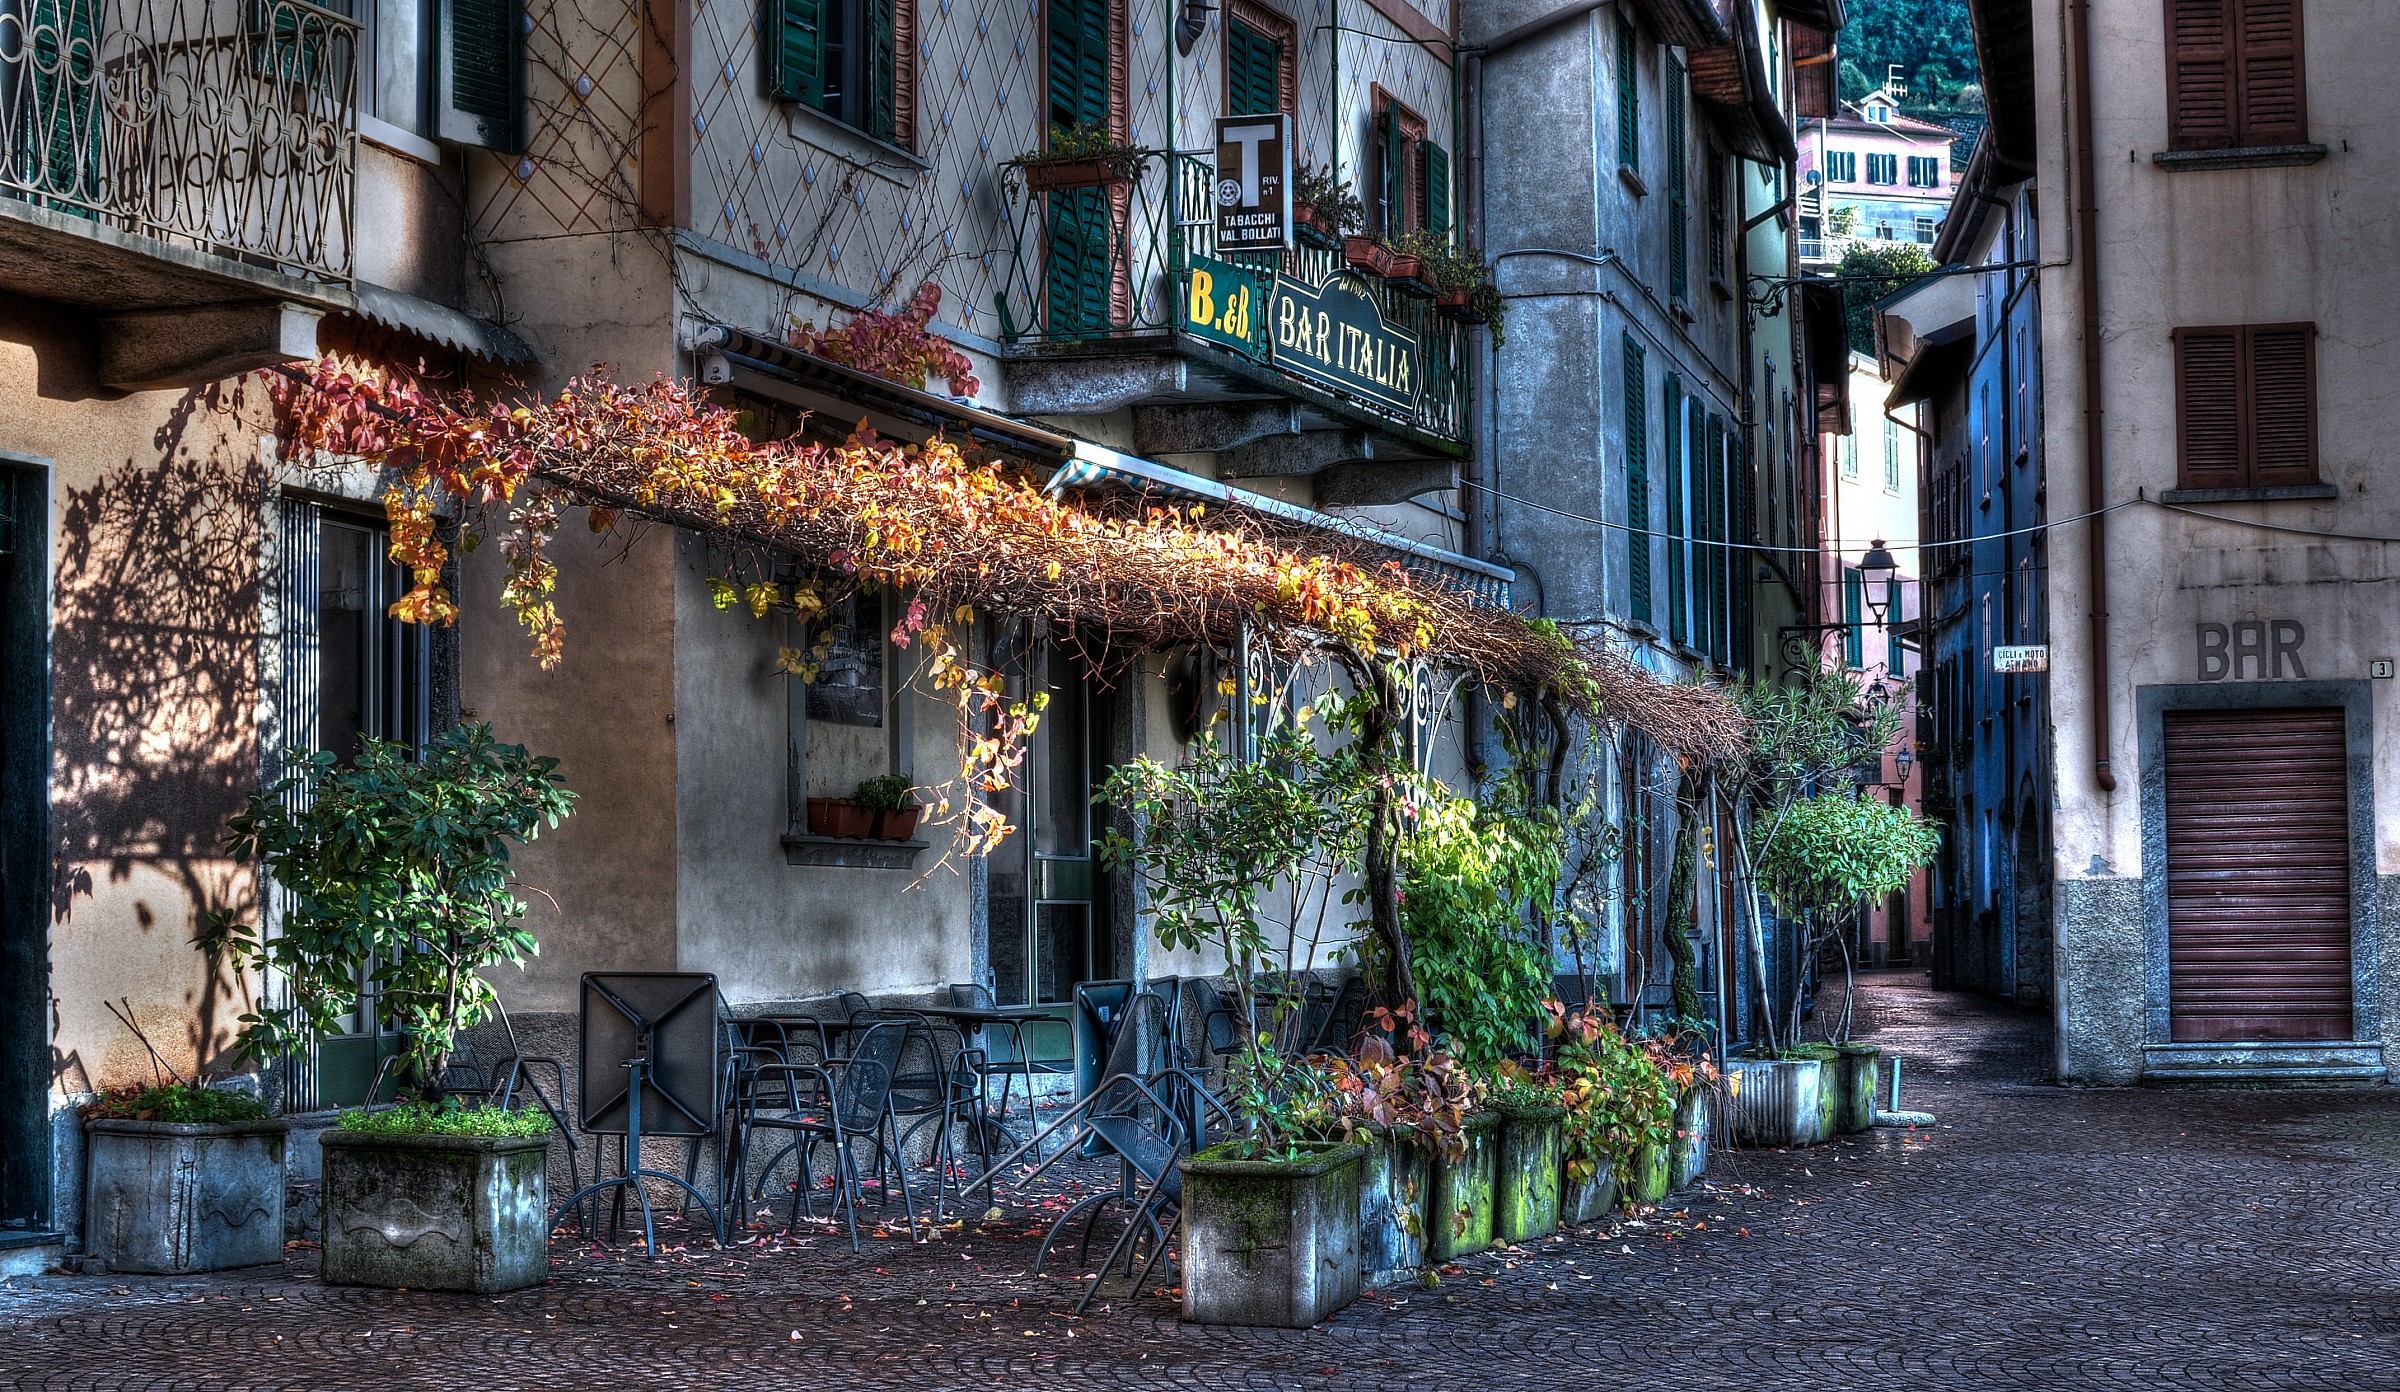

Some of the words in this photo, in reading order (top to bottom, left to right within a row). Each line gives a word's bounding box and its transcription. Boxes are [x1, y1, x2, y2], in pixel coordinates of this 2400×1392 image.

[1224, 124, 1275, 207] T
[1262, 176, 1280, 186] RIV.
[1224, 213, 1275, 227] TABACCHI
[1220, 229, 1240, 242] VAL.
[1241, 226, 1281, 240] BOLLATI
[1350, 280, 1367, 301] 1892
[1279, 295, 1332, 366] BAR
[1337, 321, 1411, 396] ITALIA
[1998, 650, 2017, 658] CICLI
[2025, 650, 2044, 658] MOTO
[2196, 619, 2307, 681] BAR
[2379, 662, 2386, 676] 3
